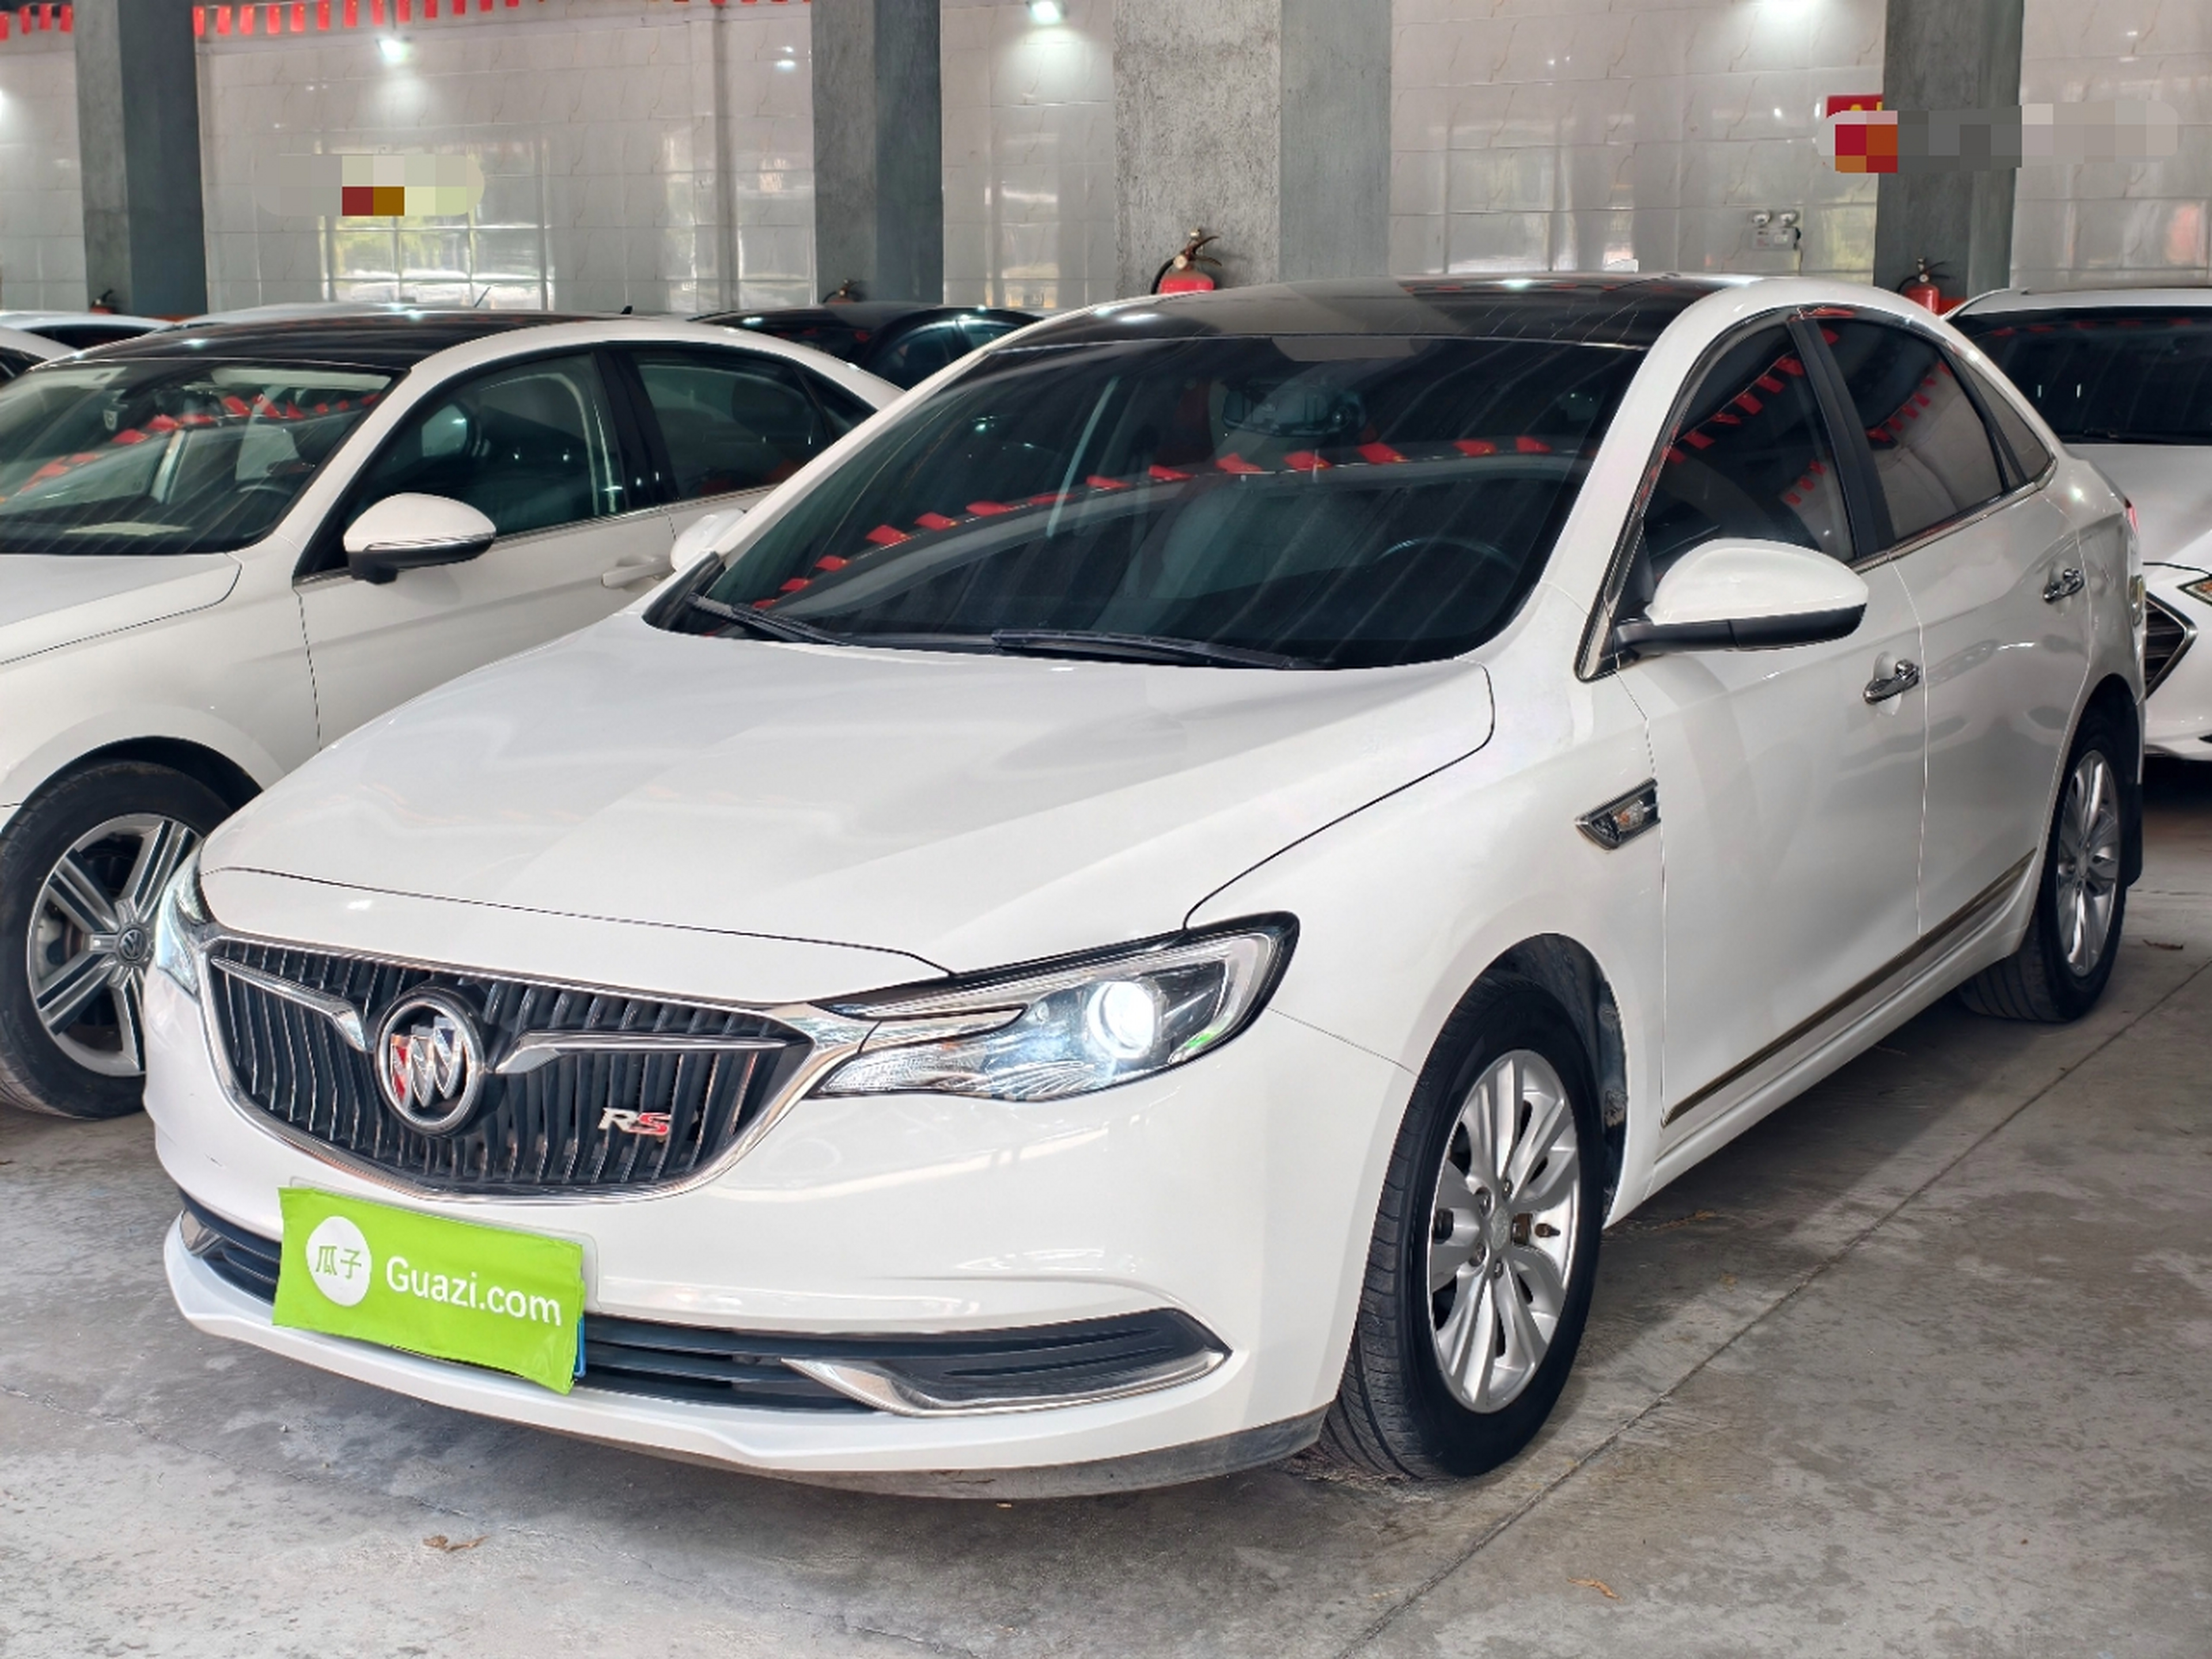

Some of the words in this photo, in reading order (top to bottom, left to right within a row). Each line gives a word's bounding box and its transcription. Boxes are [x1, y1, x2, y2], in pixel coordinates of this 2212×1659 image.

[597, 1107, 672, 1135] RS
[316, 1245, 362, 1279] 瓜子
[386, 1255, 562, 1326] Guazi.com
